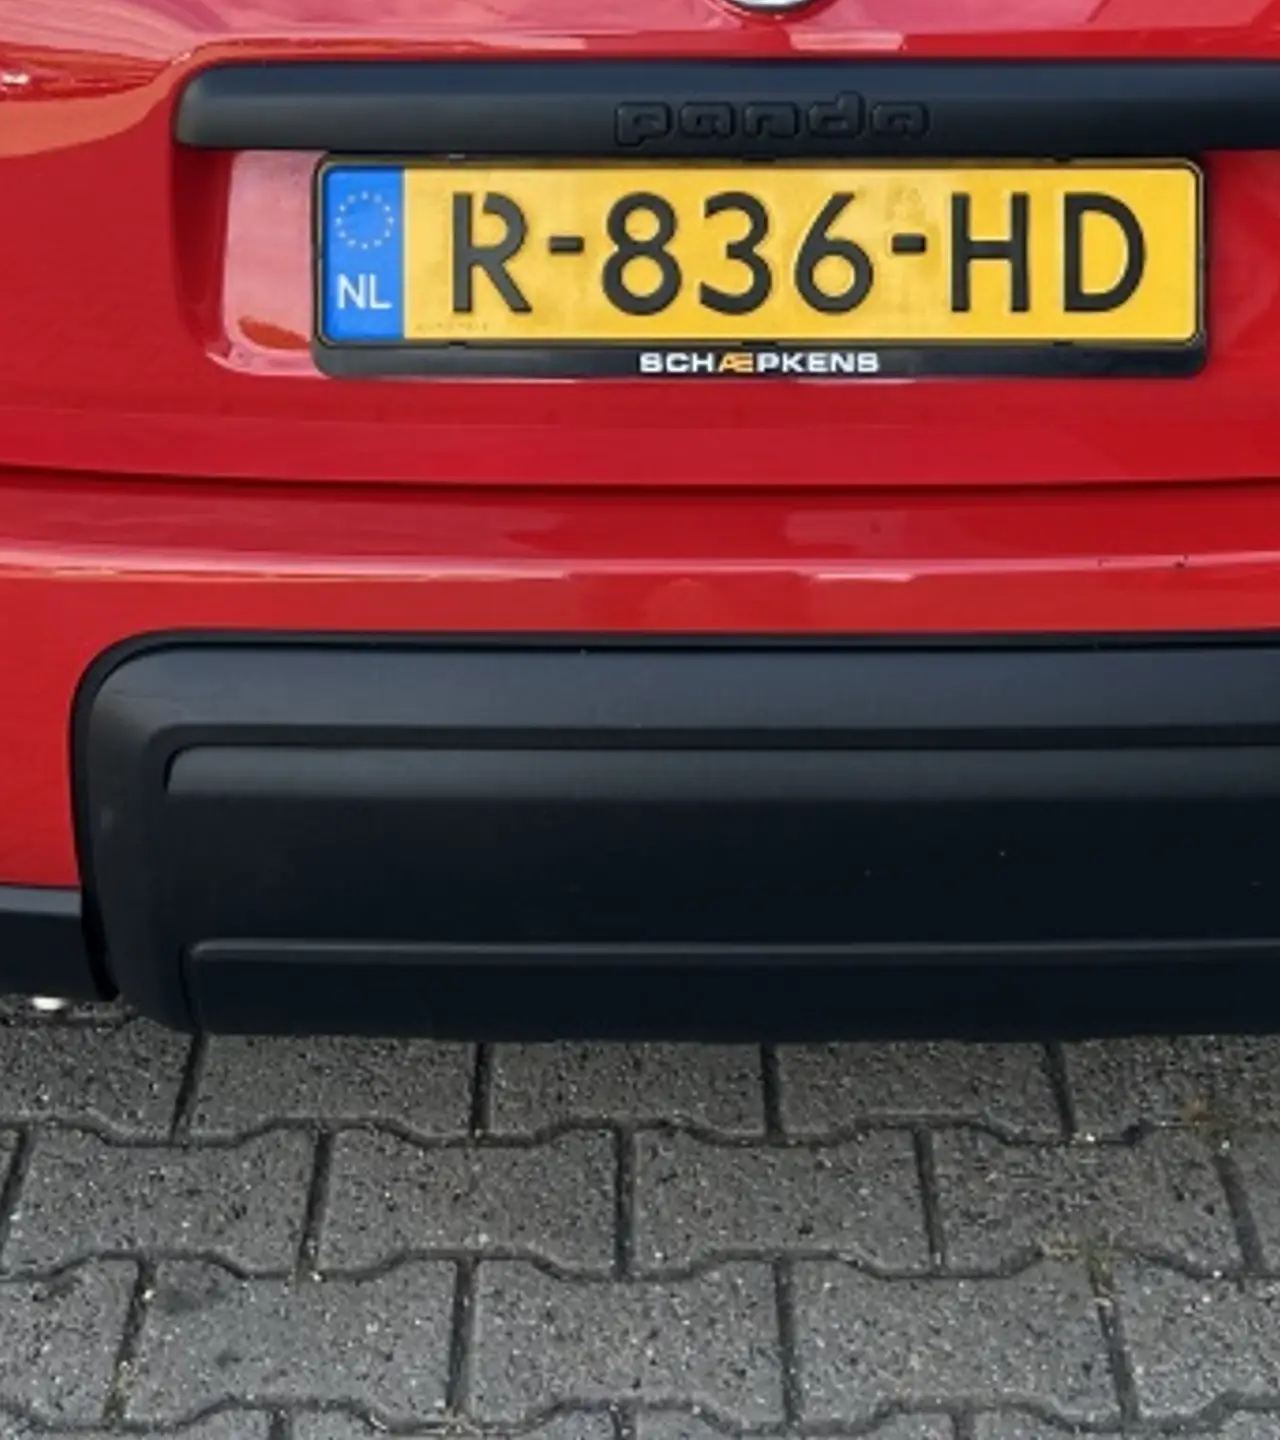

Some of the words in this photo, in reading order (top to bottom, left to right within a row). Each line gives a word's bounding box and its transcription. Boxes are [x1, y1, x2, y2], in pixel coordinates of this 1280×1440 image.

[616, 92, 930, 145] panda
[451, 192, 1146, 314] R-836-HD
[337, 273, 392, 310] NL
